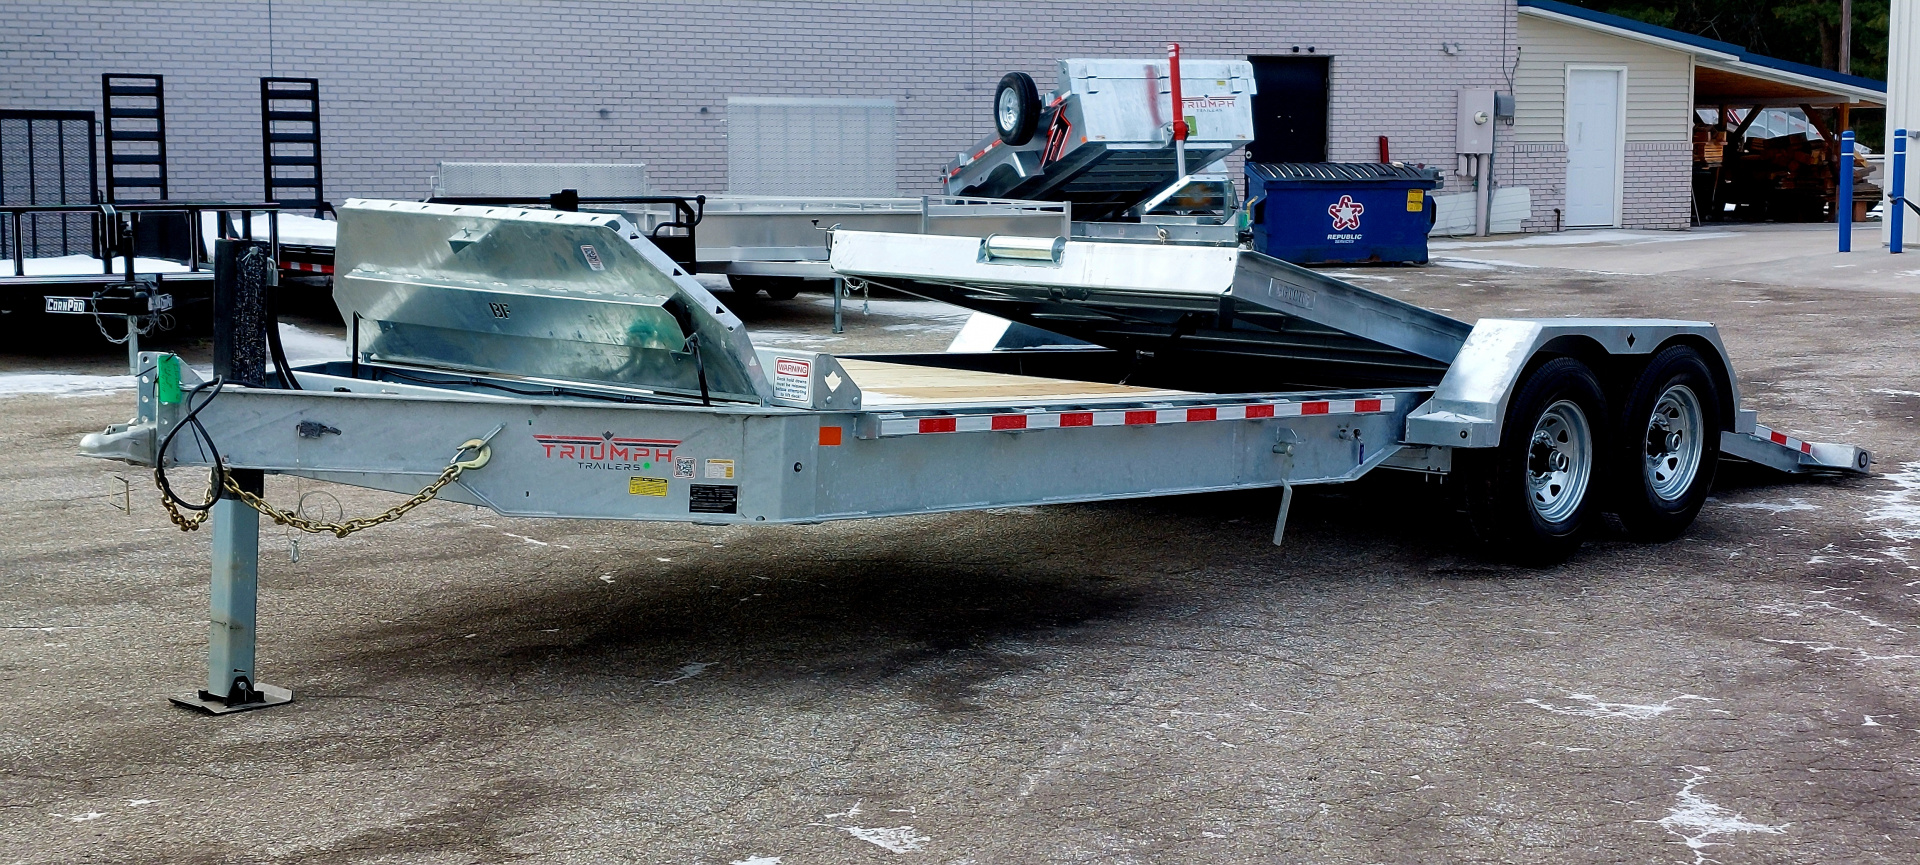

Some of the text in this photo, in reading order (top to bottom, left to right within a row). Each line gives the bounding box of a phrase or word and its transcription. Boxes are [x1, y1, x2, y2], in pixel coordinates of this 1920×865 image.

[1182, 100, 1235, 108] TRIUMPH
[779, 364, 806, 373] WARNING
[542, 443, 673, 463] TRIUMPH
[577, 461, 641, 471] TRAILERS
